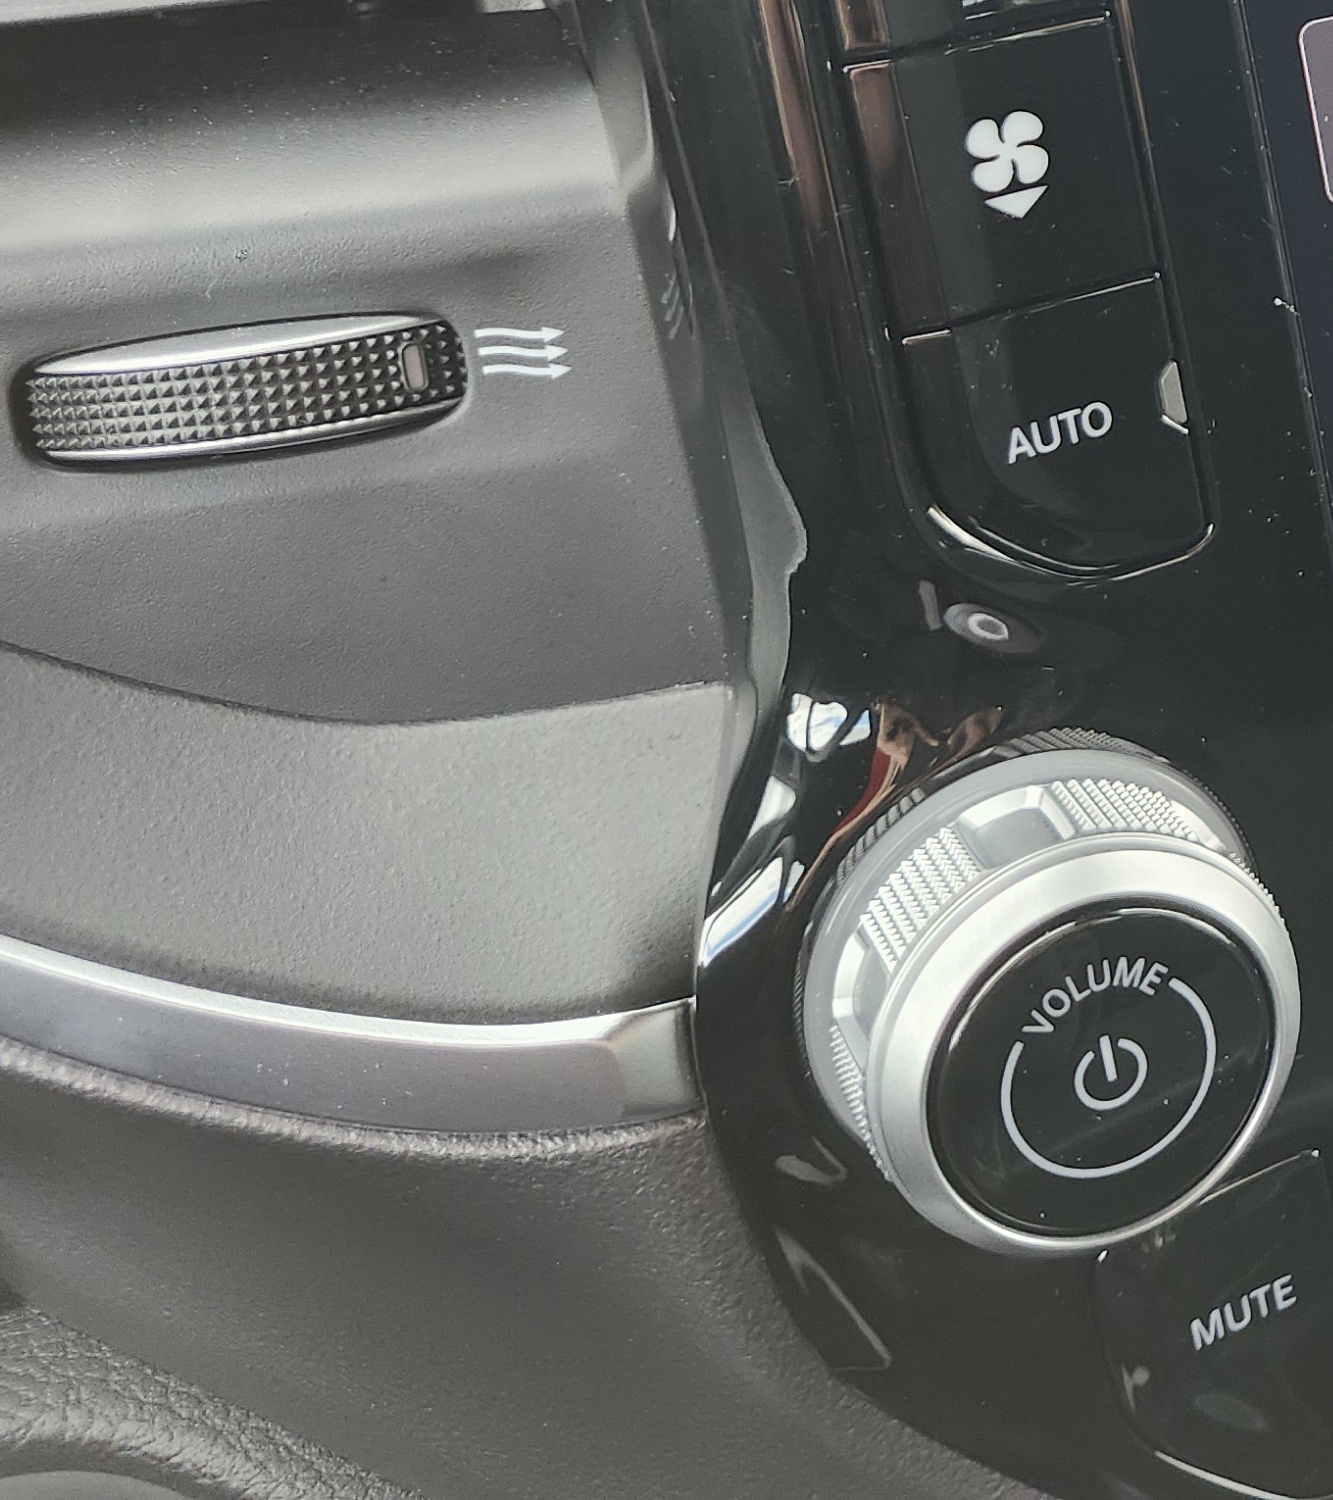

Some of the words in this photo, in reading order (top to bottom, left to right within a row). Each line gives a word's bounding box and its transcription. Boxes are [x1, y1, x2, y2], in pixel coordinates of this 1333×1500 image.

[1006, 400, 1114, 467] AUTO
[1021, 956, 1169, 1038] VOLUME
[1190, 1273, 1298, 1351] MUTE
